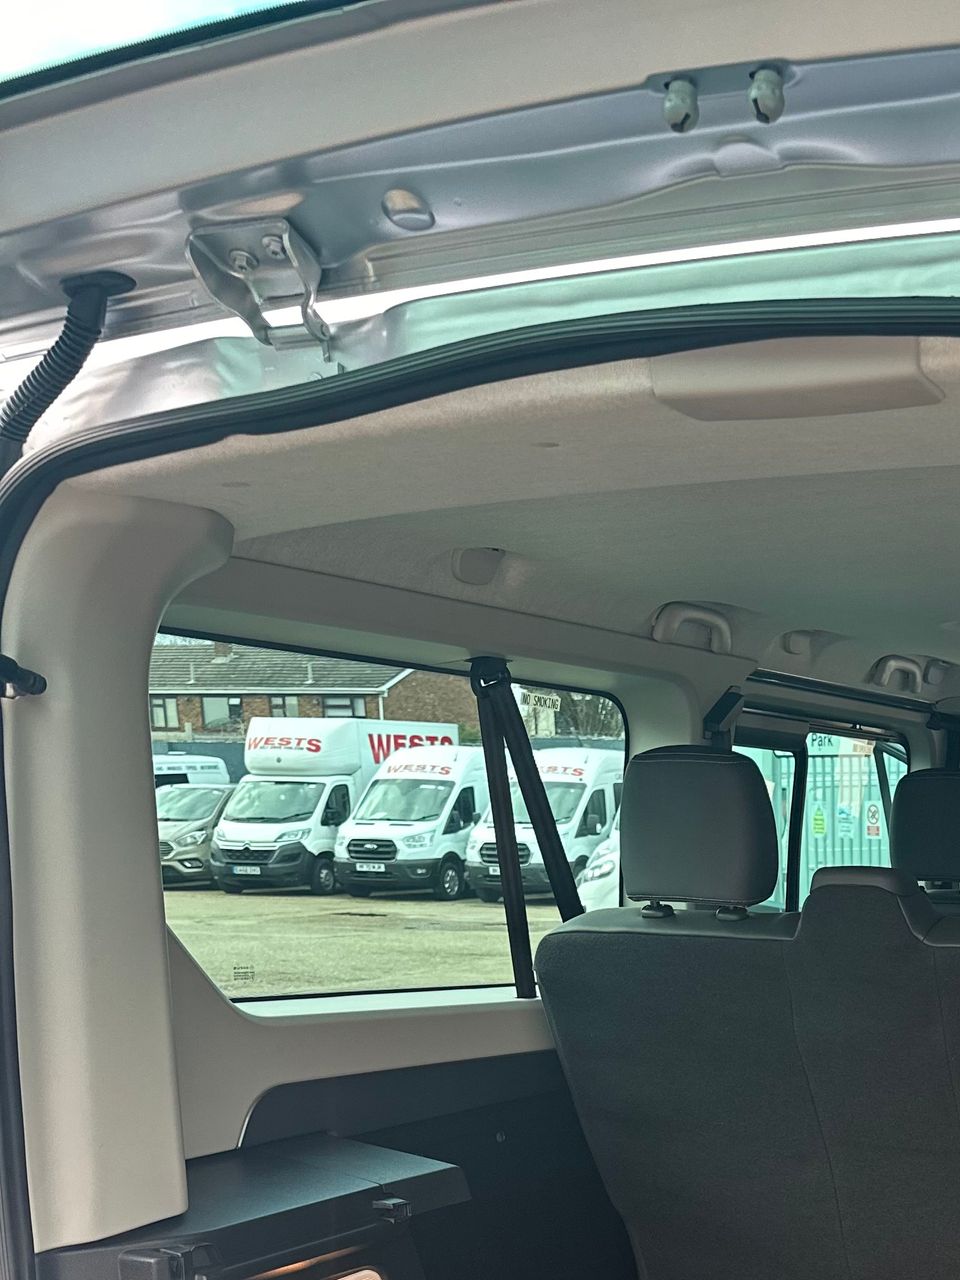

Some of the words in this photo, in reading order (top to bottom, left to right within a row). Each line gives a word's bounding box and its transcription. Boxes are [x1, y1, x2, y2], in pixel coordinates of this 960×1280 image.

[522, 692, 531, 705] NO
[533, 695, 559, 709] SMOKING
[247, 737, 322, 753] WESTS
[811, 733, 833, 747] Park
[387, 764, 452, 775] WESTS
